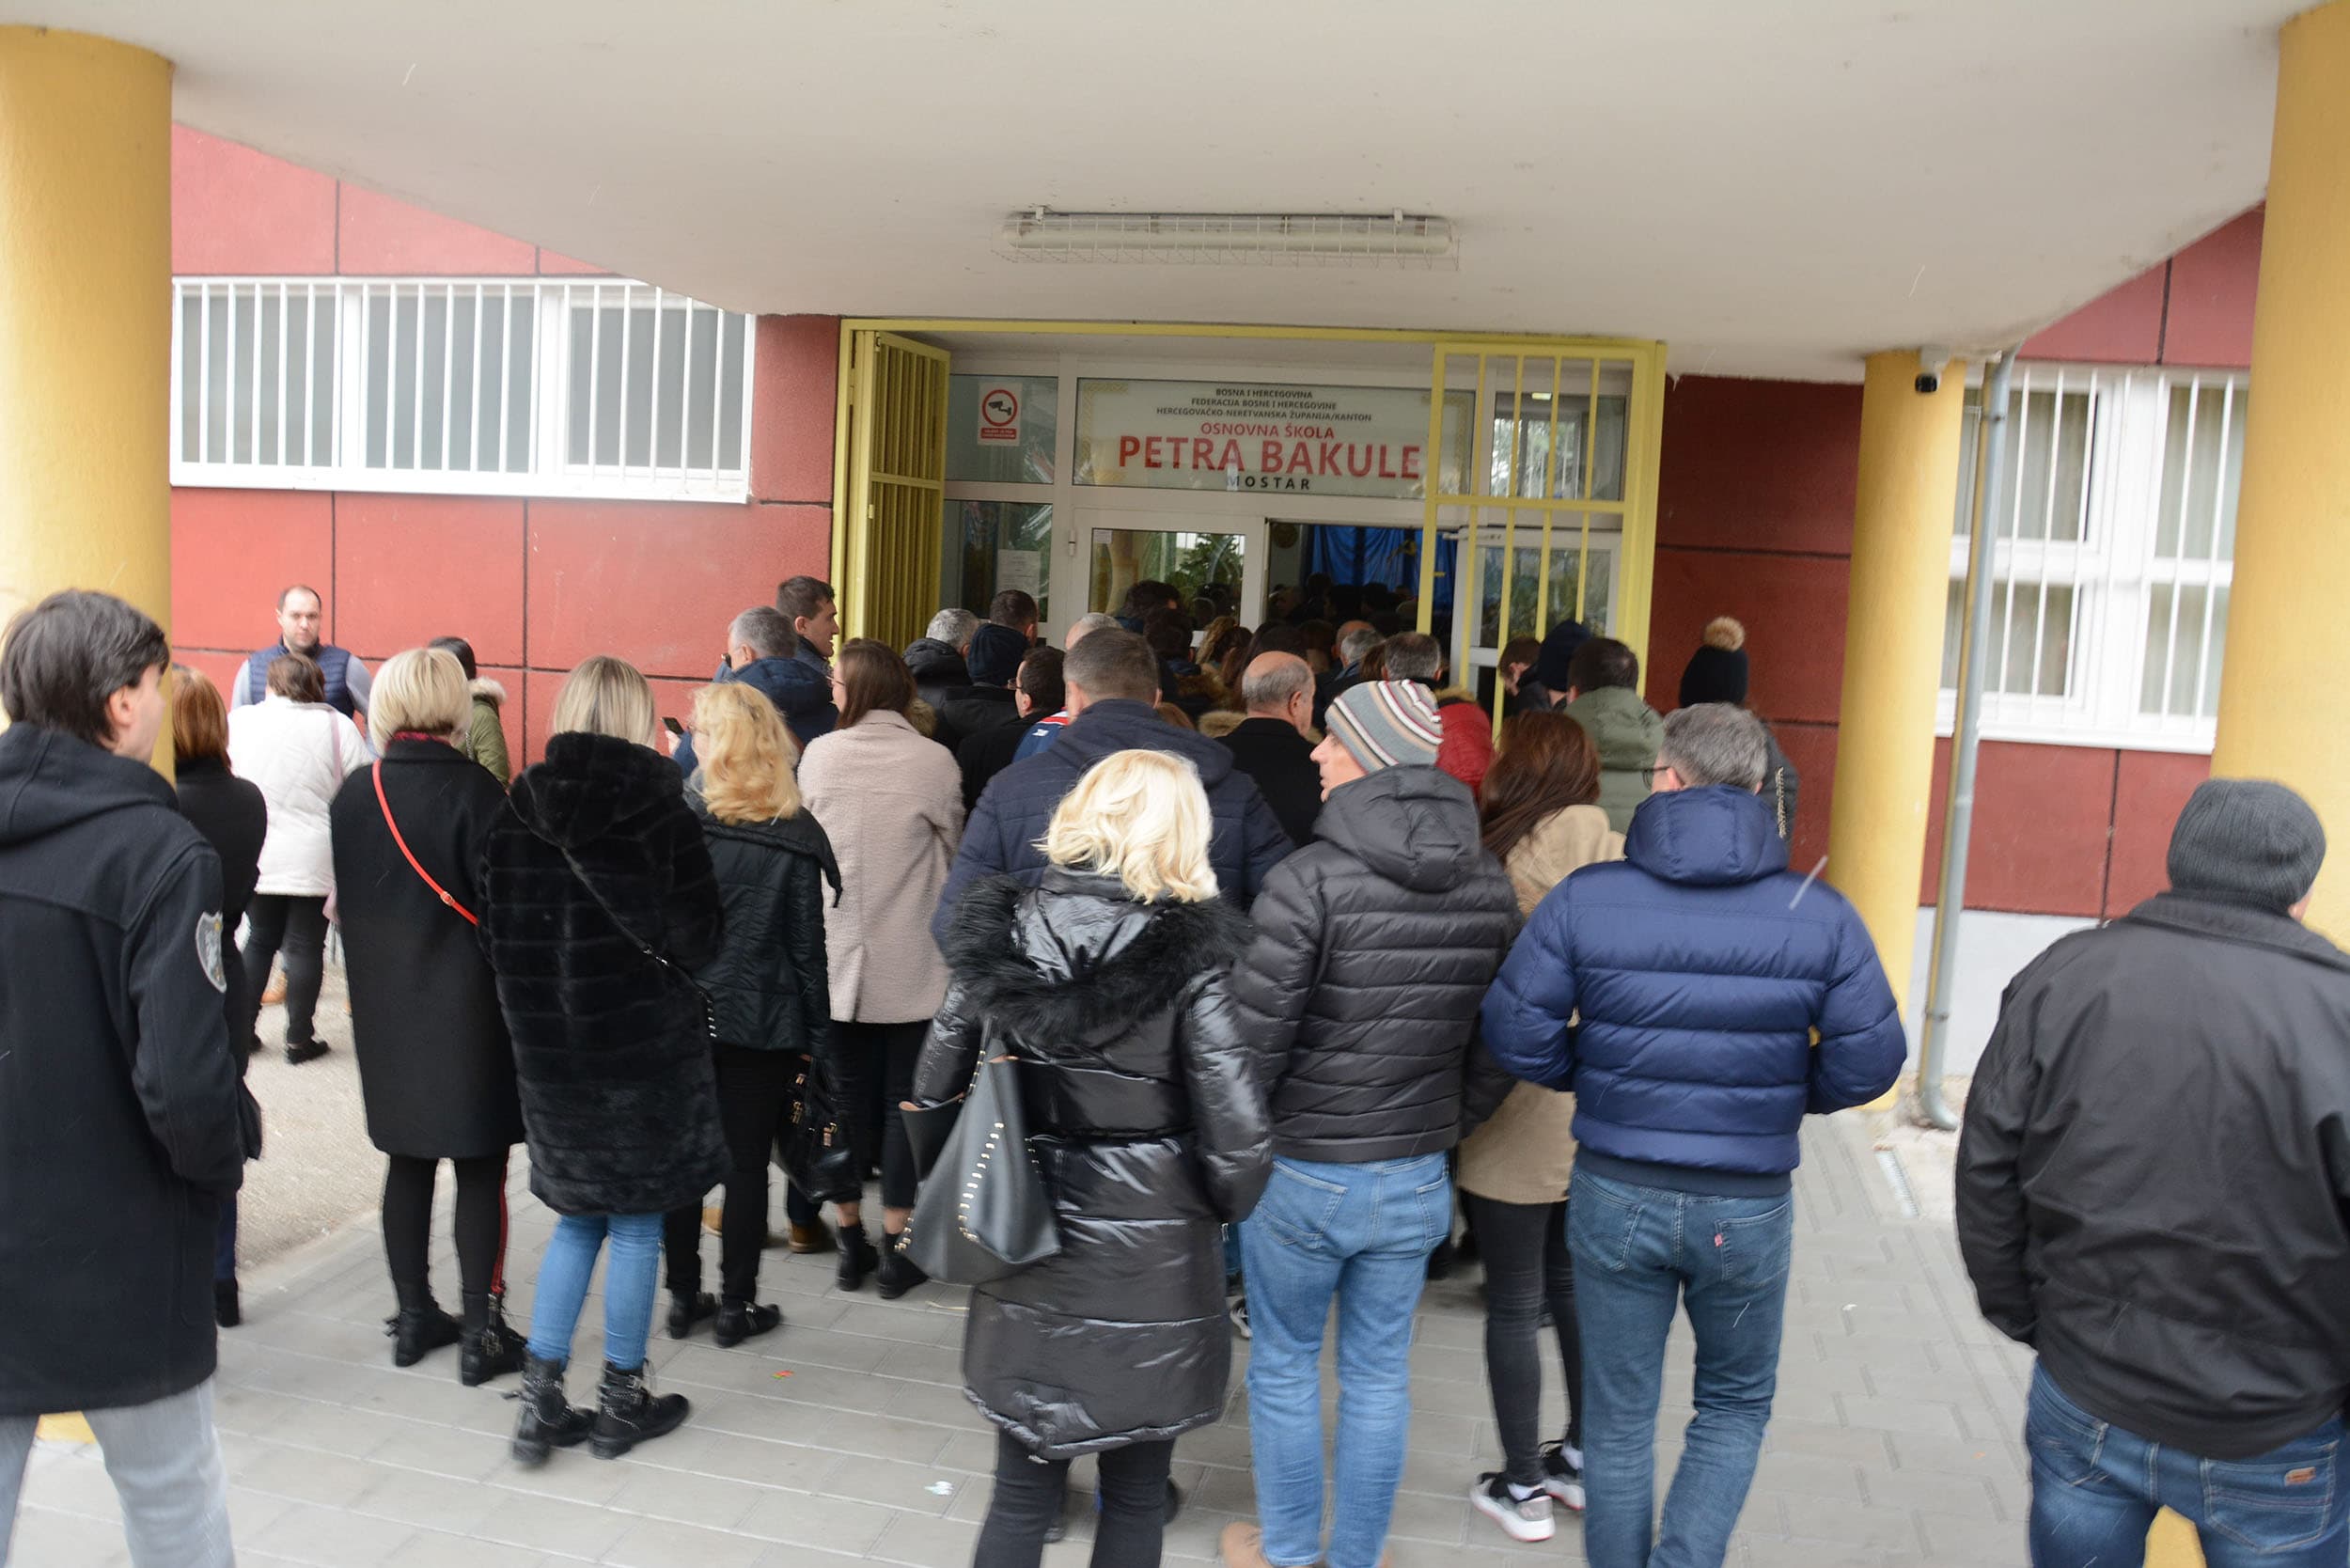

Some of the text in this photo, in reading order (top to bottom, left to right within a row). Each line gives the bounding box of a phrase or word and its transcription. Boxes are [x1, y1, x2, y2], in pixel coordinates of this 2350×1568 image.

[1215, 388, 1245, 398] BOSNA
[1252, 389, 1313, 399] HERCEGOVINA
[1191, 398, 1240, 407] FEDERACIJA
[1242, 400, 1270, 408] BOSNE
[1277, 400, 1337, 411] HERCEGOVINE
[1200, 420, 1335, 439] OSNOVNA ŠKOLA
[1119, 435, 1420, 479] PETRA BAKULE
